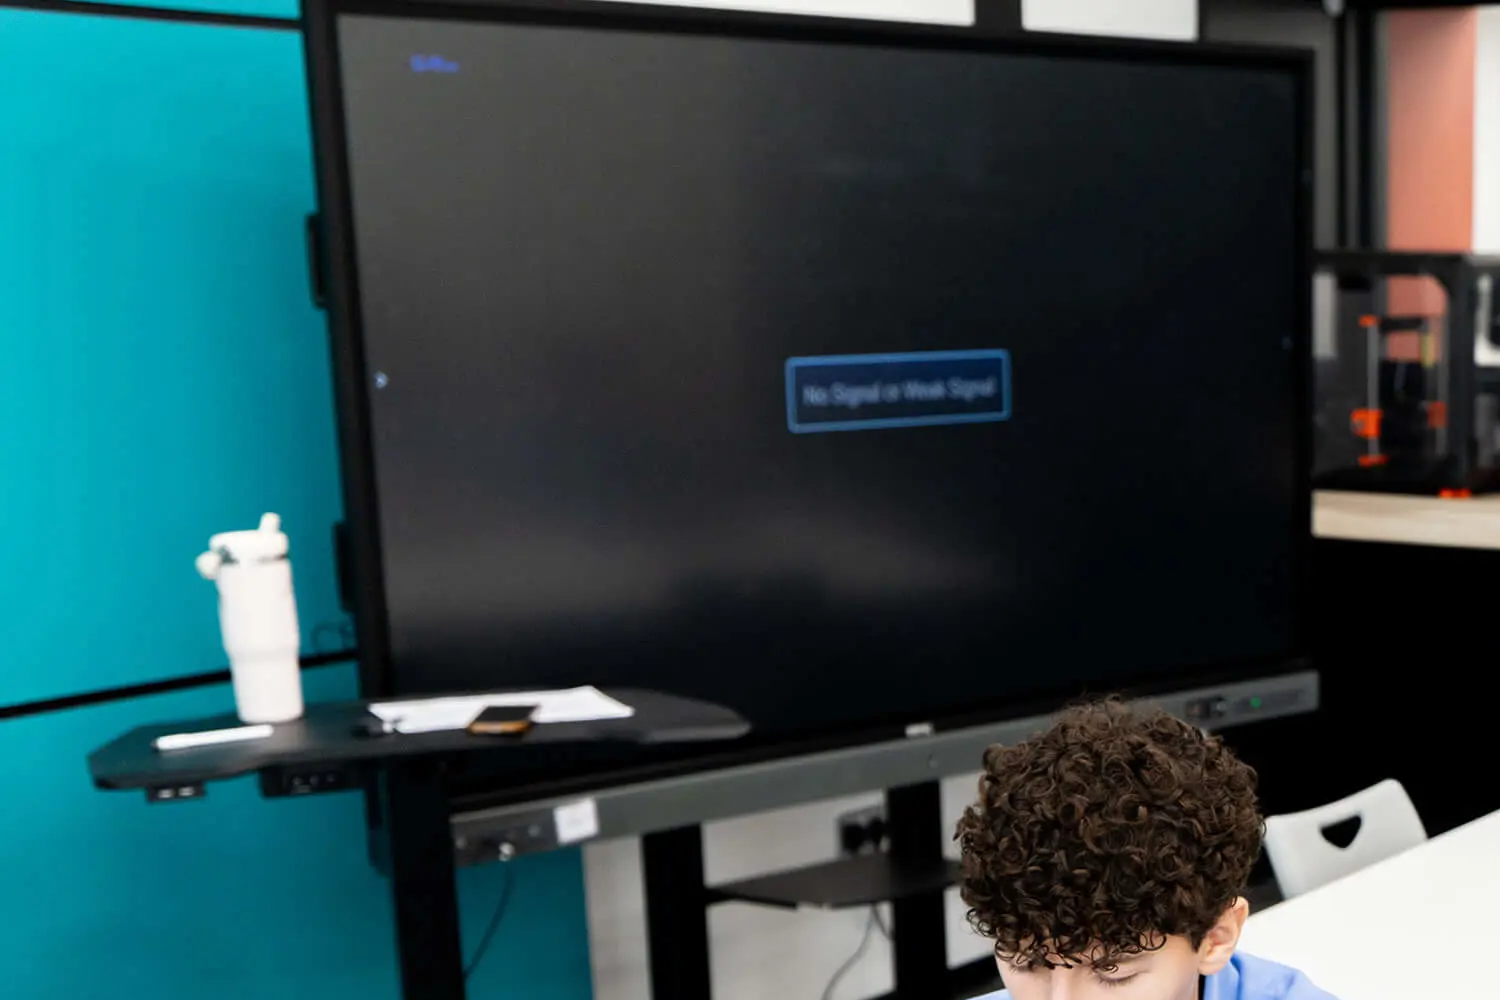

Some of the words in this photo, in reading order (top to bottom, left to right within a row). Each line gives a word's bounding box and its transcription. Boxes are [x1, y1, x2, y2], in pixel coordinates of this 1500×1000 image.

[803, 385, 828, 406] No
[830, 381, 880, 408] Signal
[903, 378, 945, 402] Weak
[948, 375, 997, 402] Signal
